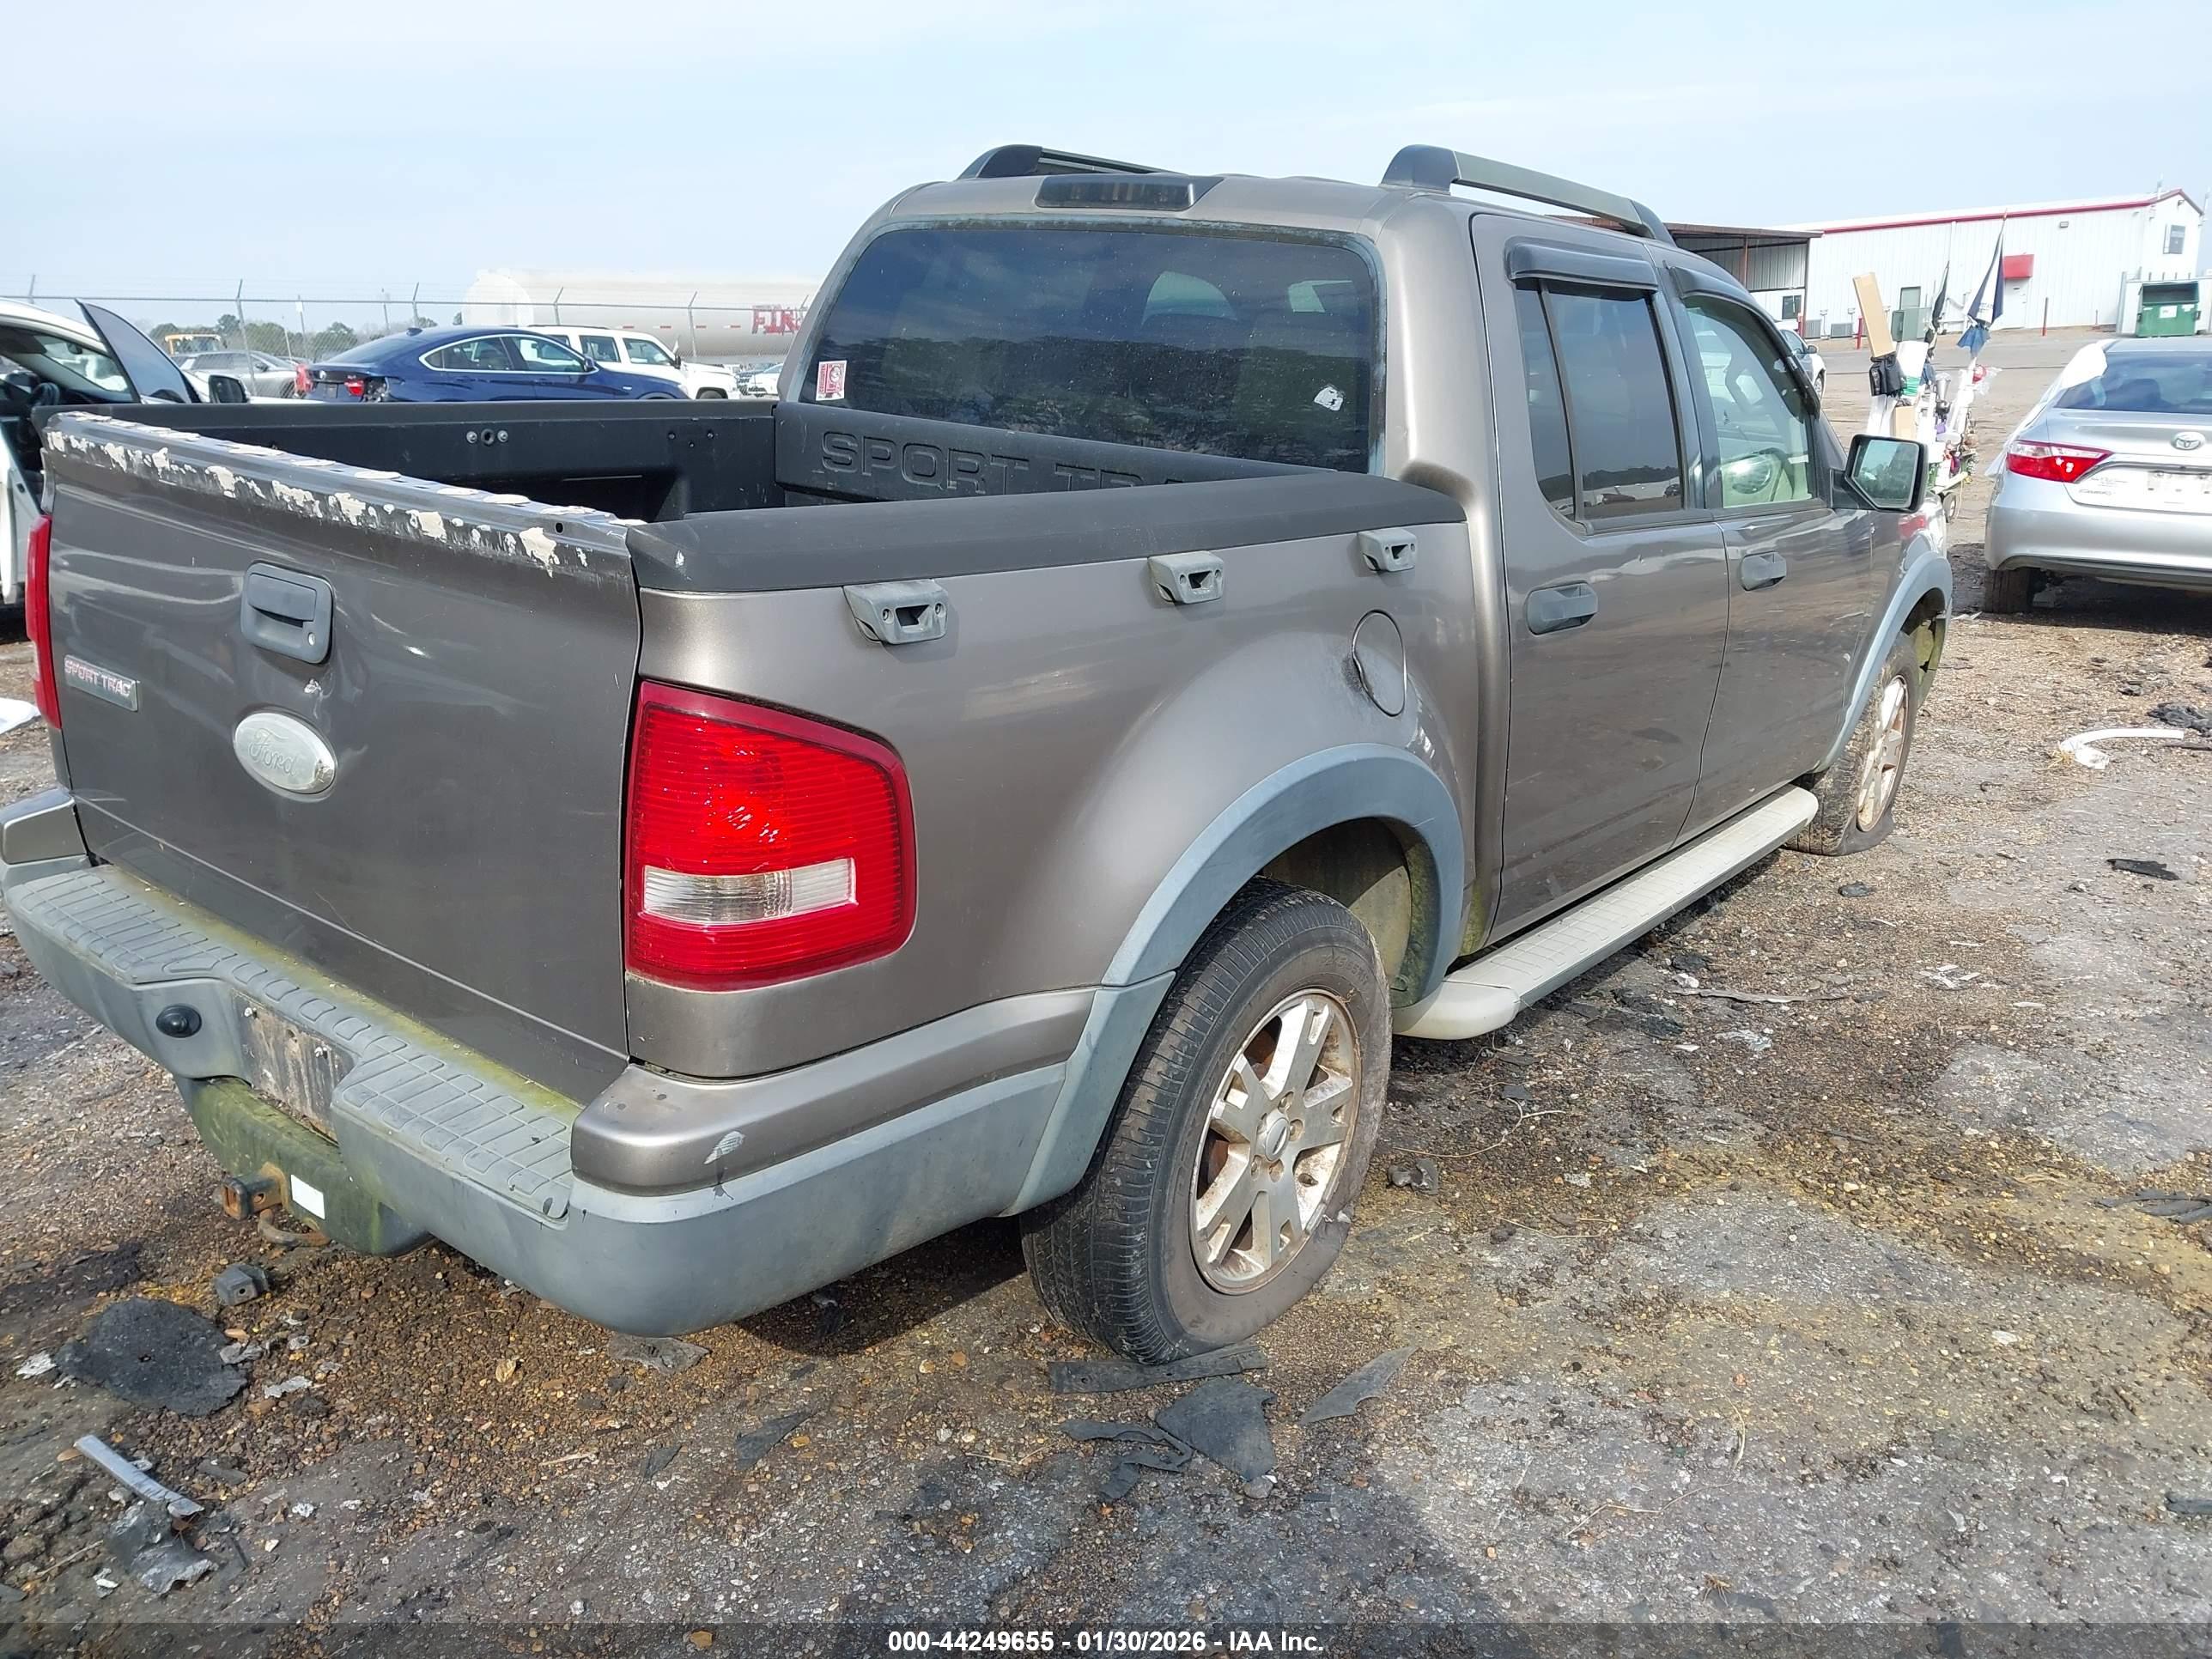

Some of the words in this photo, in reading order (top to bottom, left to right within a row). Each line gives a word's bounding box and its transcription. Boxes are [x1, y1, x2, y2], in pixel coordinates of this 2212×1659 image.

[822, 430, 1030, 495] SPORT
[64, 659, 100, 686] SPORT
[100, 673, 131, 698] TRAC
[247, 727, 298, 777] Ford
